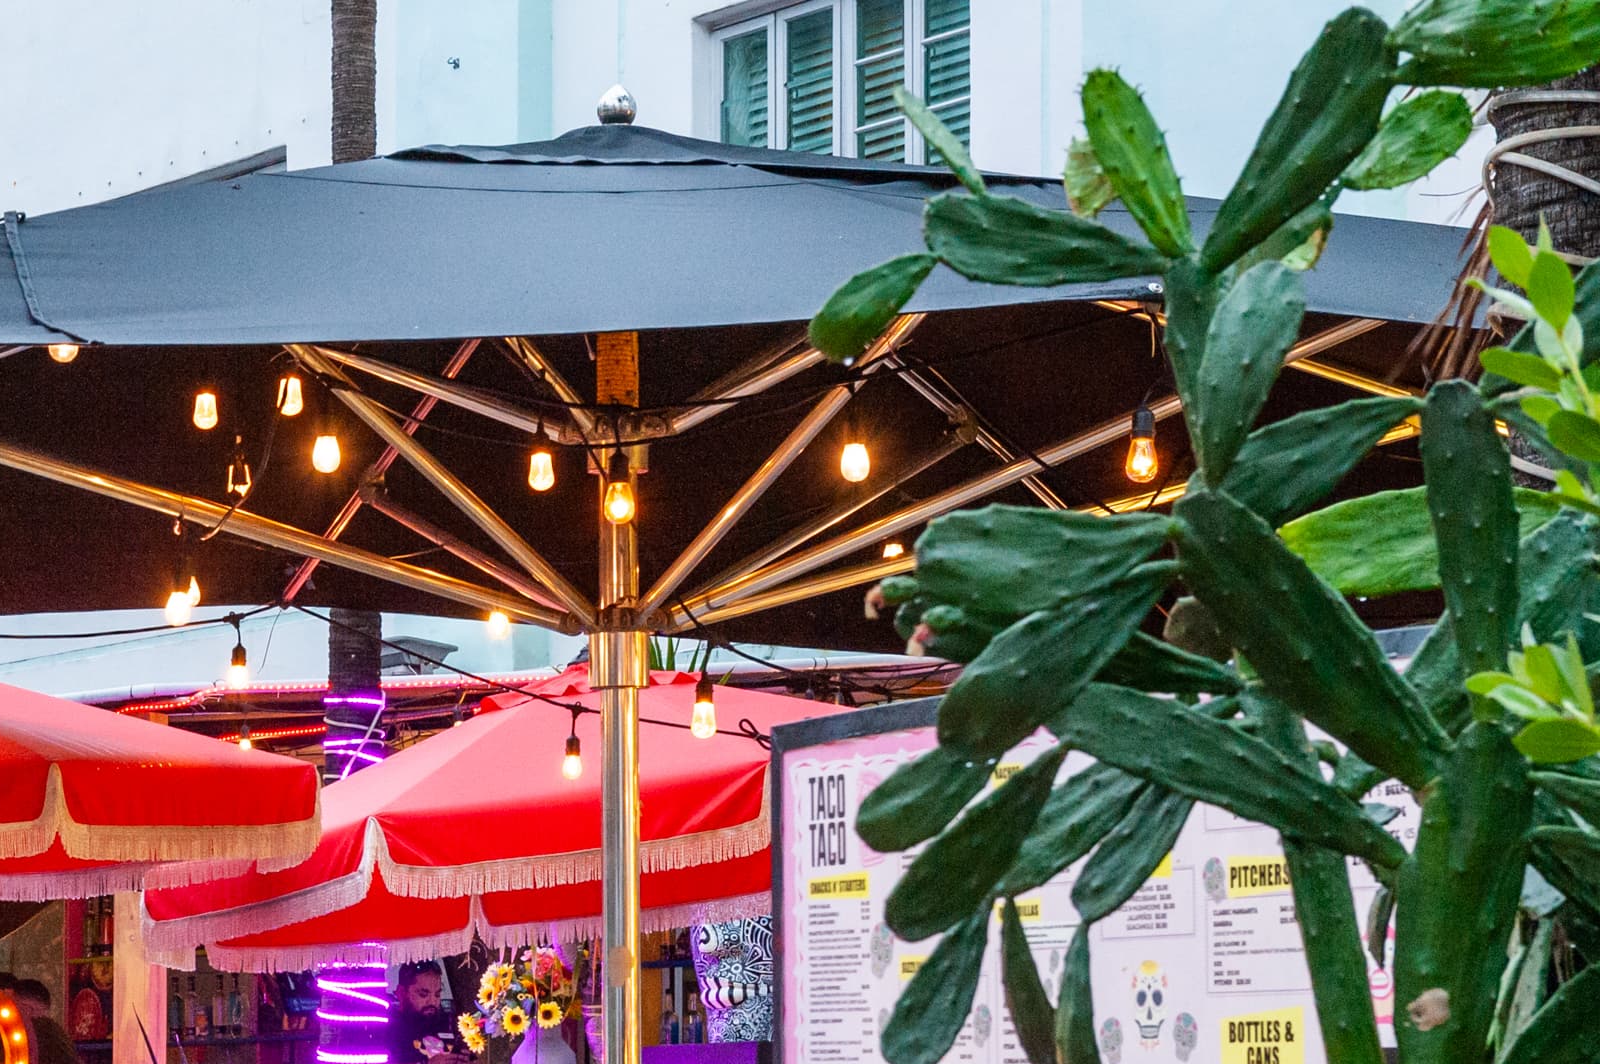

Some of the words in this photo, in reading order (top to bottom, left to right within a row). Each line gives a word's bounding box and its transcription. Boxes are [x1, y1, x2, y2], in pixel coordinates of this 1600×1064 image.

[808, 774, 846, 821] TACO
[1230, 863, 1290, 889] PITCHERS
[1229, 1021, 1280, 1043] BOTTLES
[1285, 1021, 1294, 1042] &
